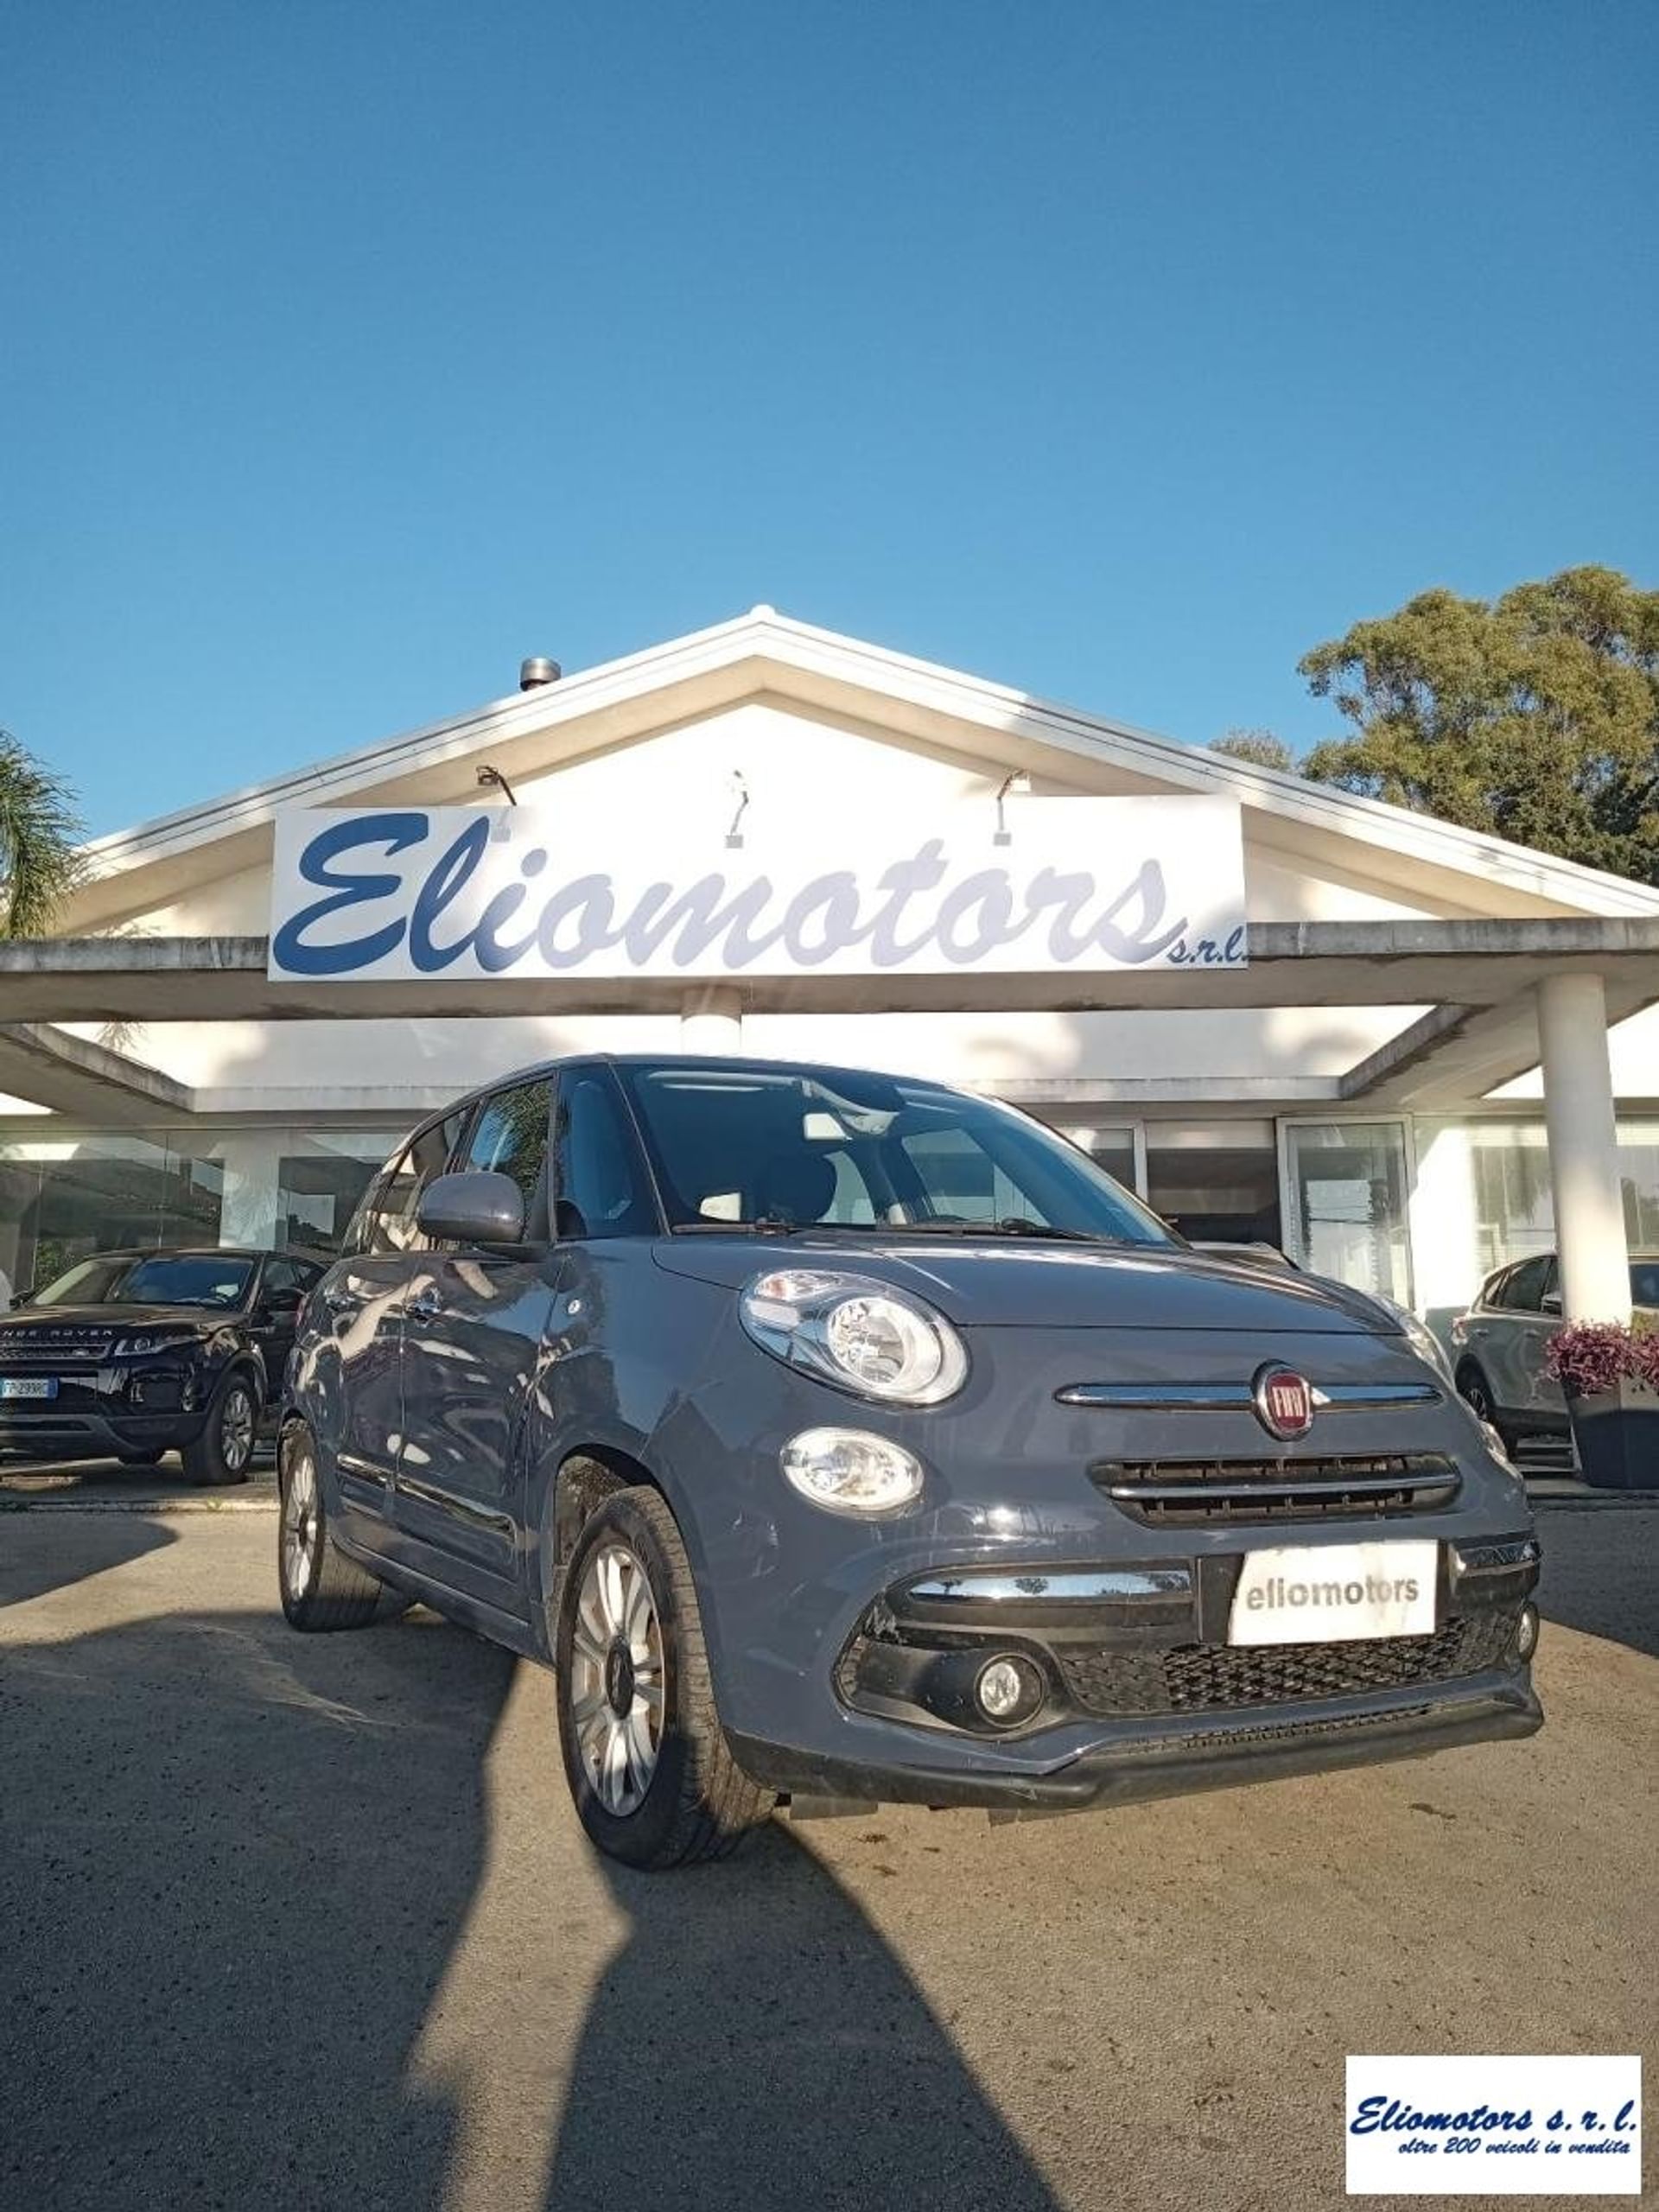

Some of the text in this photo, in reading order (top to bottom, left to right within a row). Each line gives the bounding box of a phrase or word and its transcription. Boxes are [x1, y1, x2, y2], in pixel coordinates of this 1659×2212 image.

[272, 812, 1249, 975] Eliomotors s.r.l.
[1272, 1385, 1305, 1418] FIAT
[1246, 1574, 1419, 1611] eliomotors
